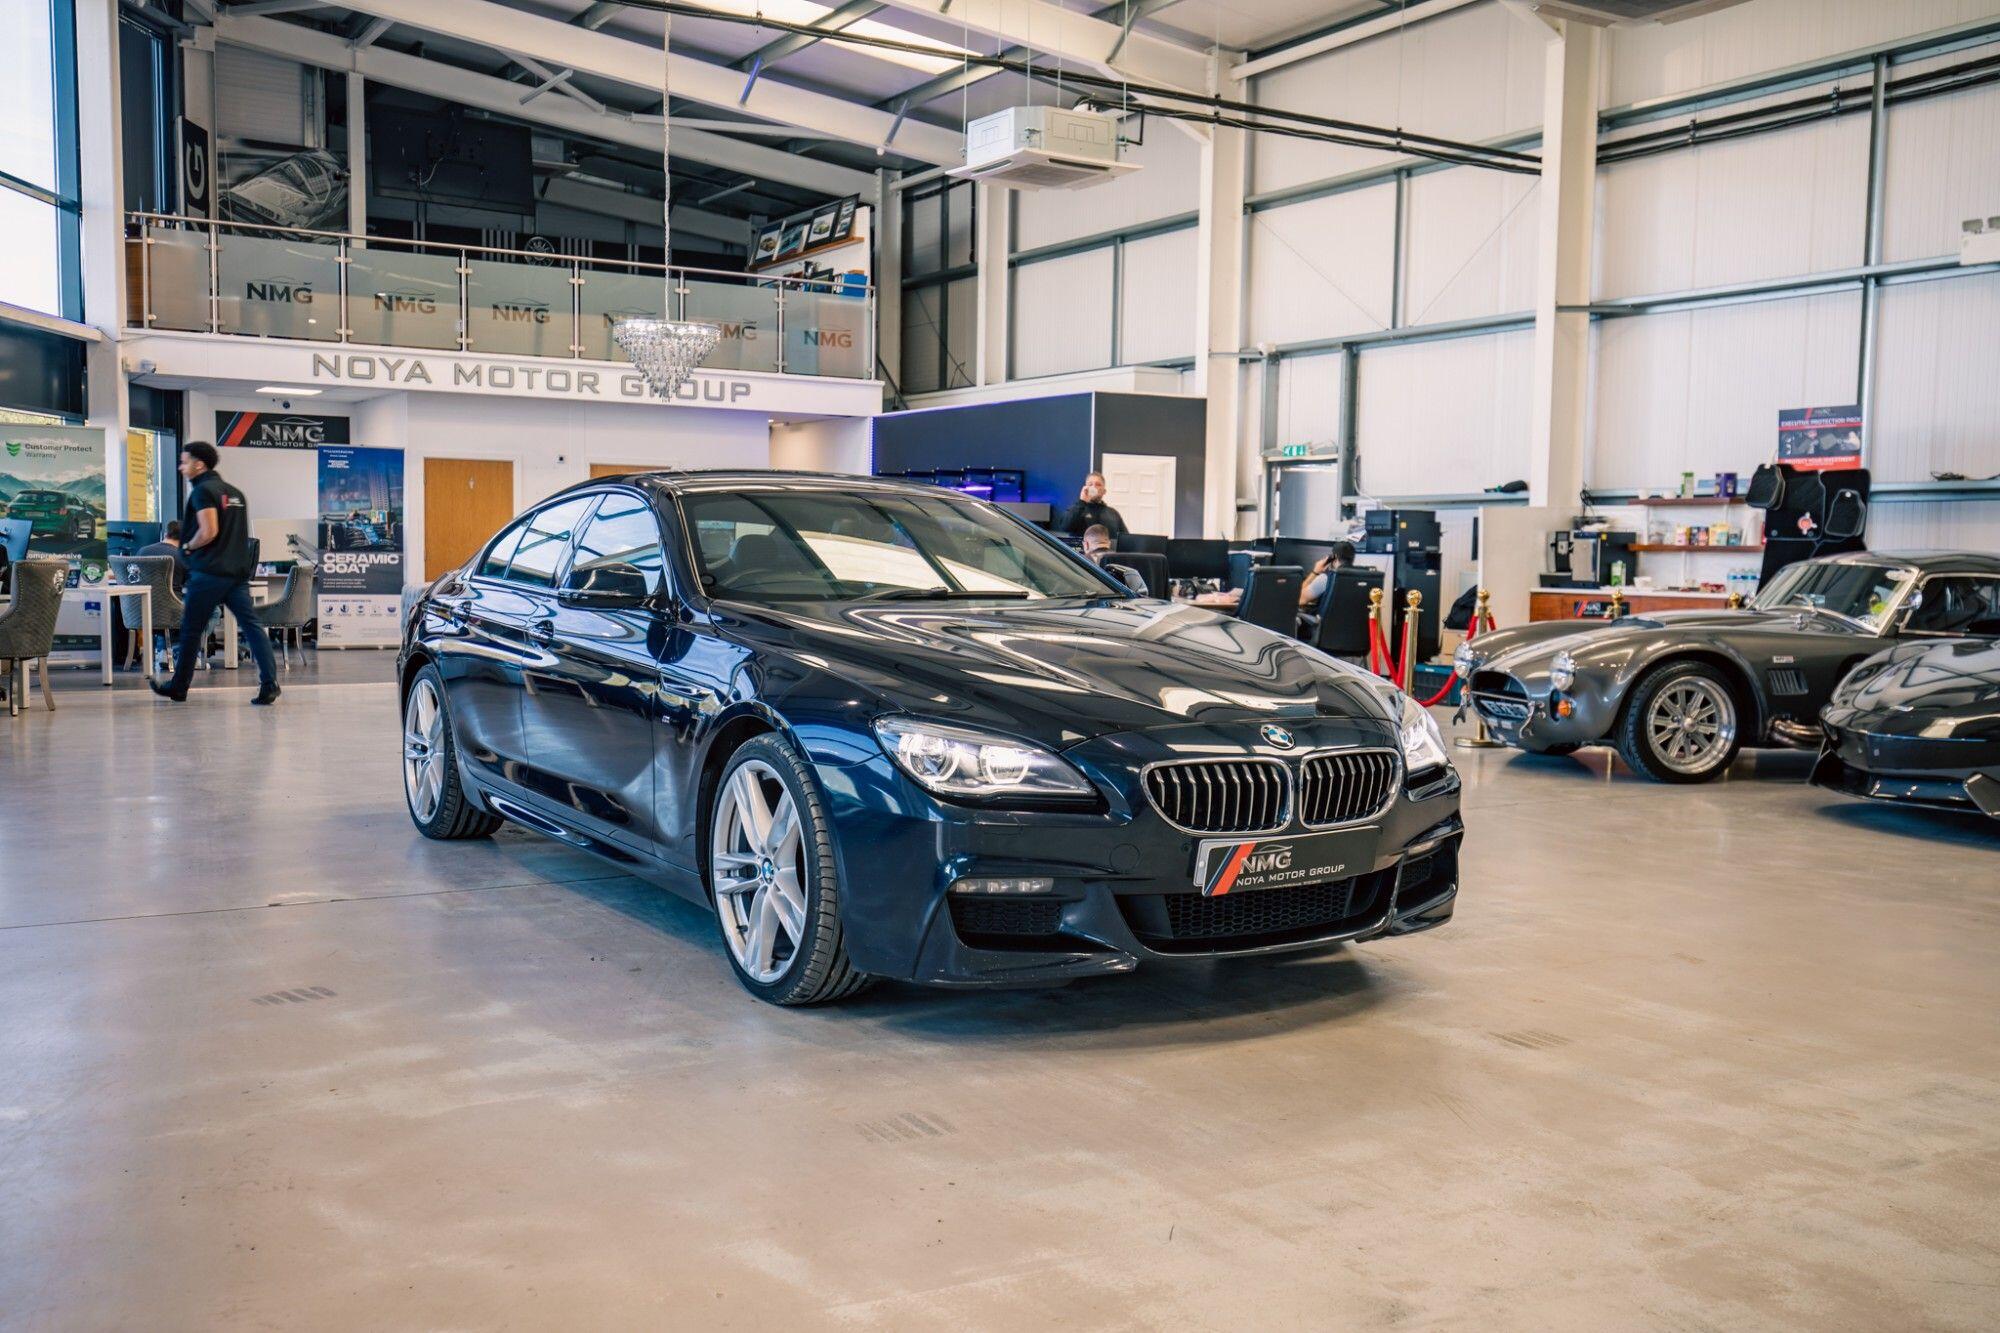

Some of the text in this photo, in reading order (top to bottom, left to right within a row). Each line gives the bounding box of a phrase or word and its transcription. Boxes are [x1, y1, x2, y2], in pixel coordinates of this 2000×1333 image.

[246, 282, 313, 304] NMG
[374, 294, 436, 314] NMG
[492, 303, 550, 324] NMG
[719, 323, 758, 341] MG
[804, 330, 852, 348] NMG
[313, 353, 751, 402] NOYA MOTOR GOUP
[261, 424, 324, 442] NMG
[25, 443, 62, 451] Customer
[323, 552, 399, 564] CERAMIC
[323, 563, 370, 574] COAT
[1239, 851, 1292, 875] NMG
[1236, 874, 1265, 886] NOYA
[1269, 869, 1306, 881] MOTOR
[1309, 864, 1345, 876] GROUP
